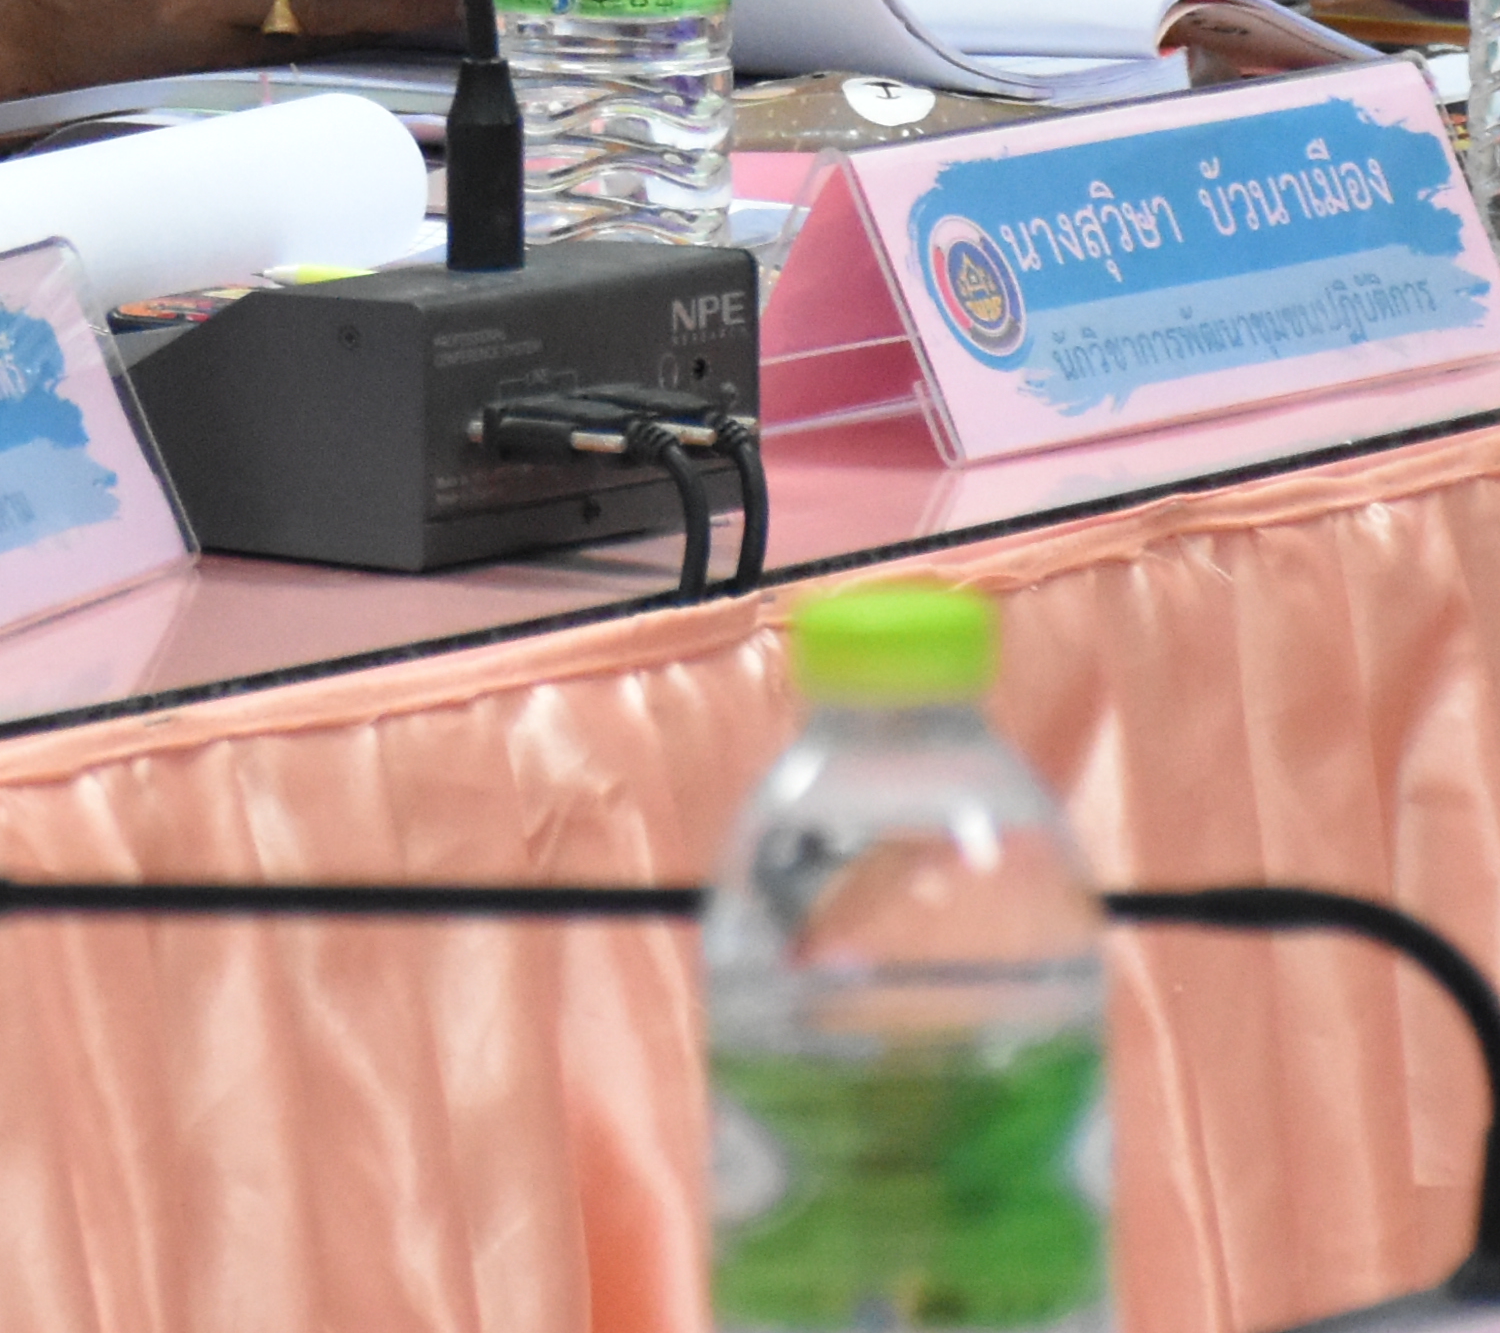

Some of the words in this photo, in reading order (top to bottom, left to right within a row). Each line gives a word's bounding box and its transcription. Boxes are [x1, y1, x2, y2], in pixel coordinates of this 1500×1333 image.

[1000, 180, 1184, 283] นางสุวิษา
[1199, 137, 1394, 237] บัวนาเมือง
[671, 290, 746, 331] NPE
